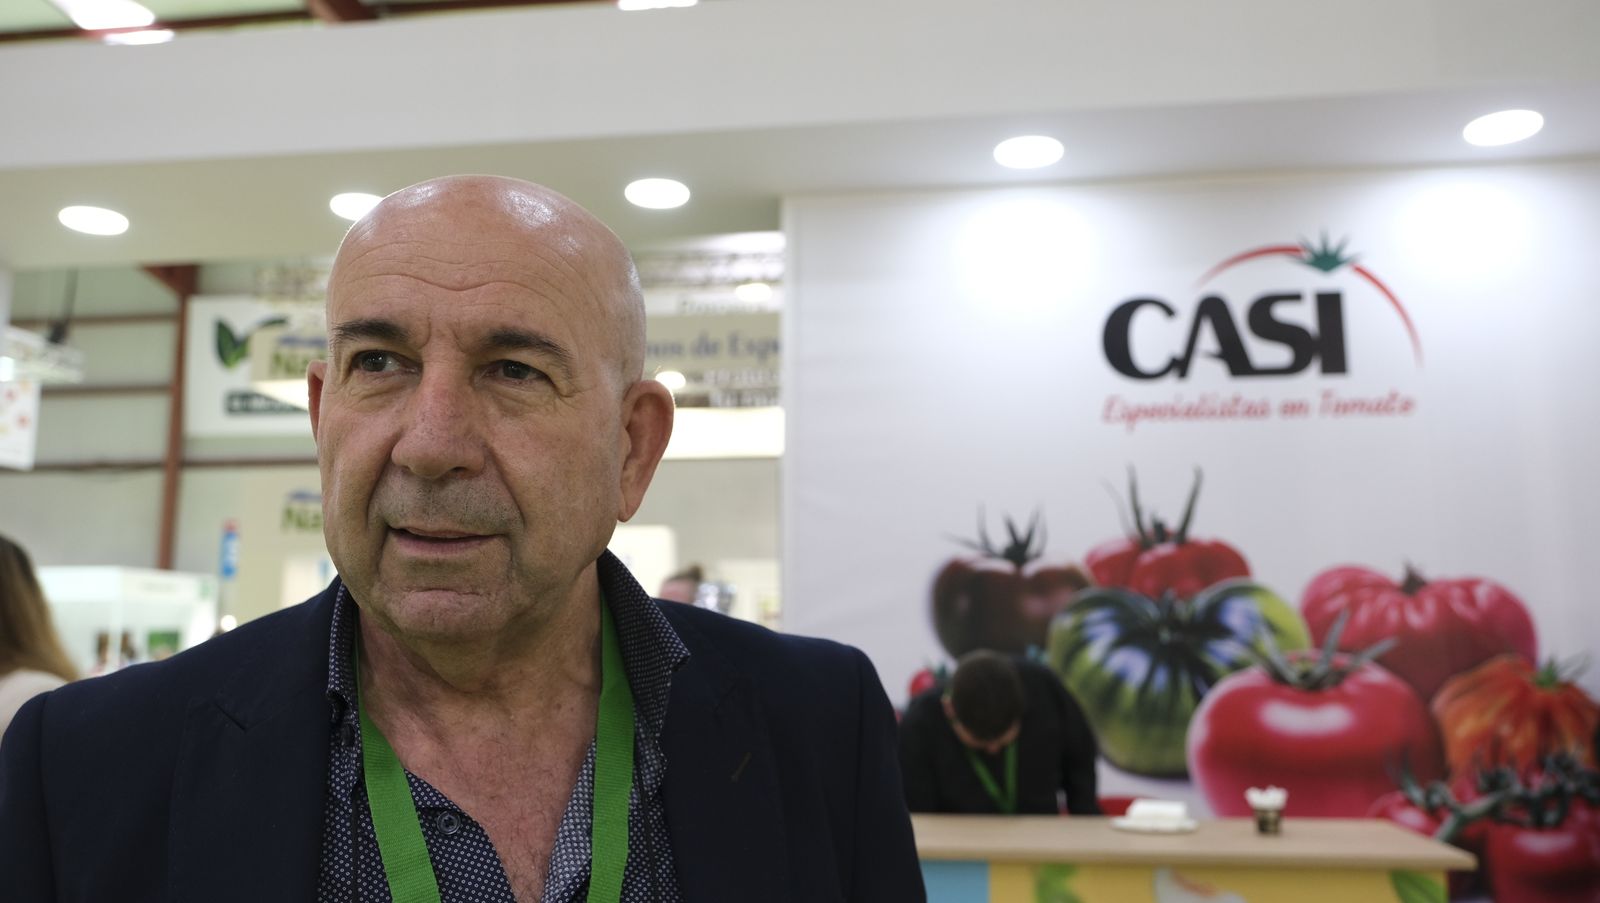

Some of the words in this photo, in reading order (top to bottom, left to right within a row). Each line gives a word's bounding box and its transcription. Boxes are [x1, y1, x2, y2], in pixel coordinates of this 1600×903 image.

[1102, 291, 1348, 380] CASI
[1102, 396, 1271, 431] Especialistas
[1279, 400, 1310, 418] en
